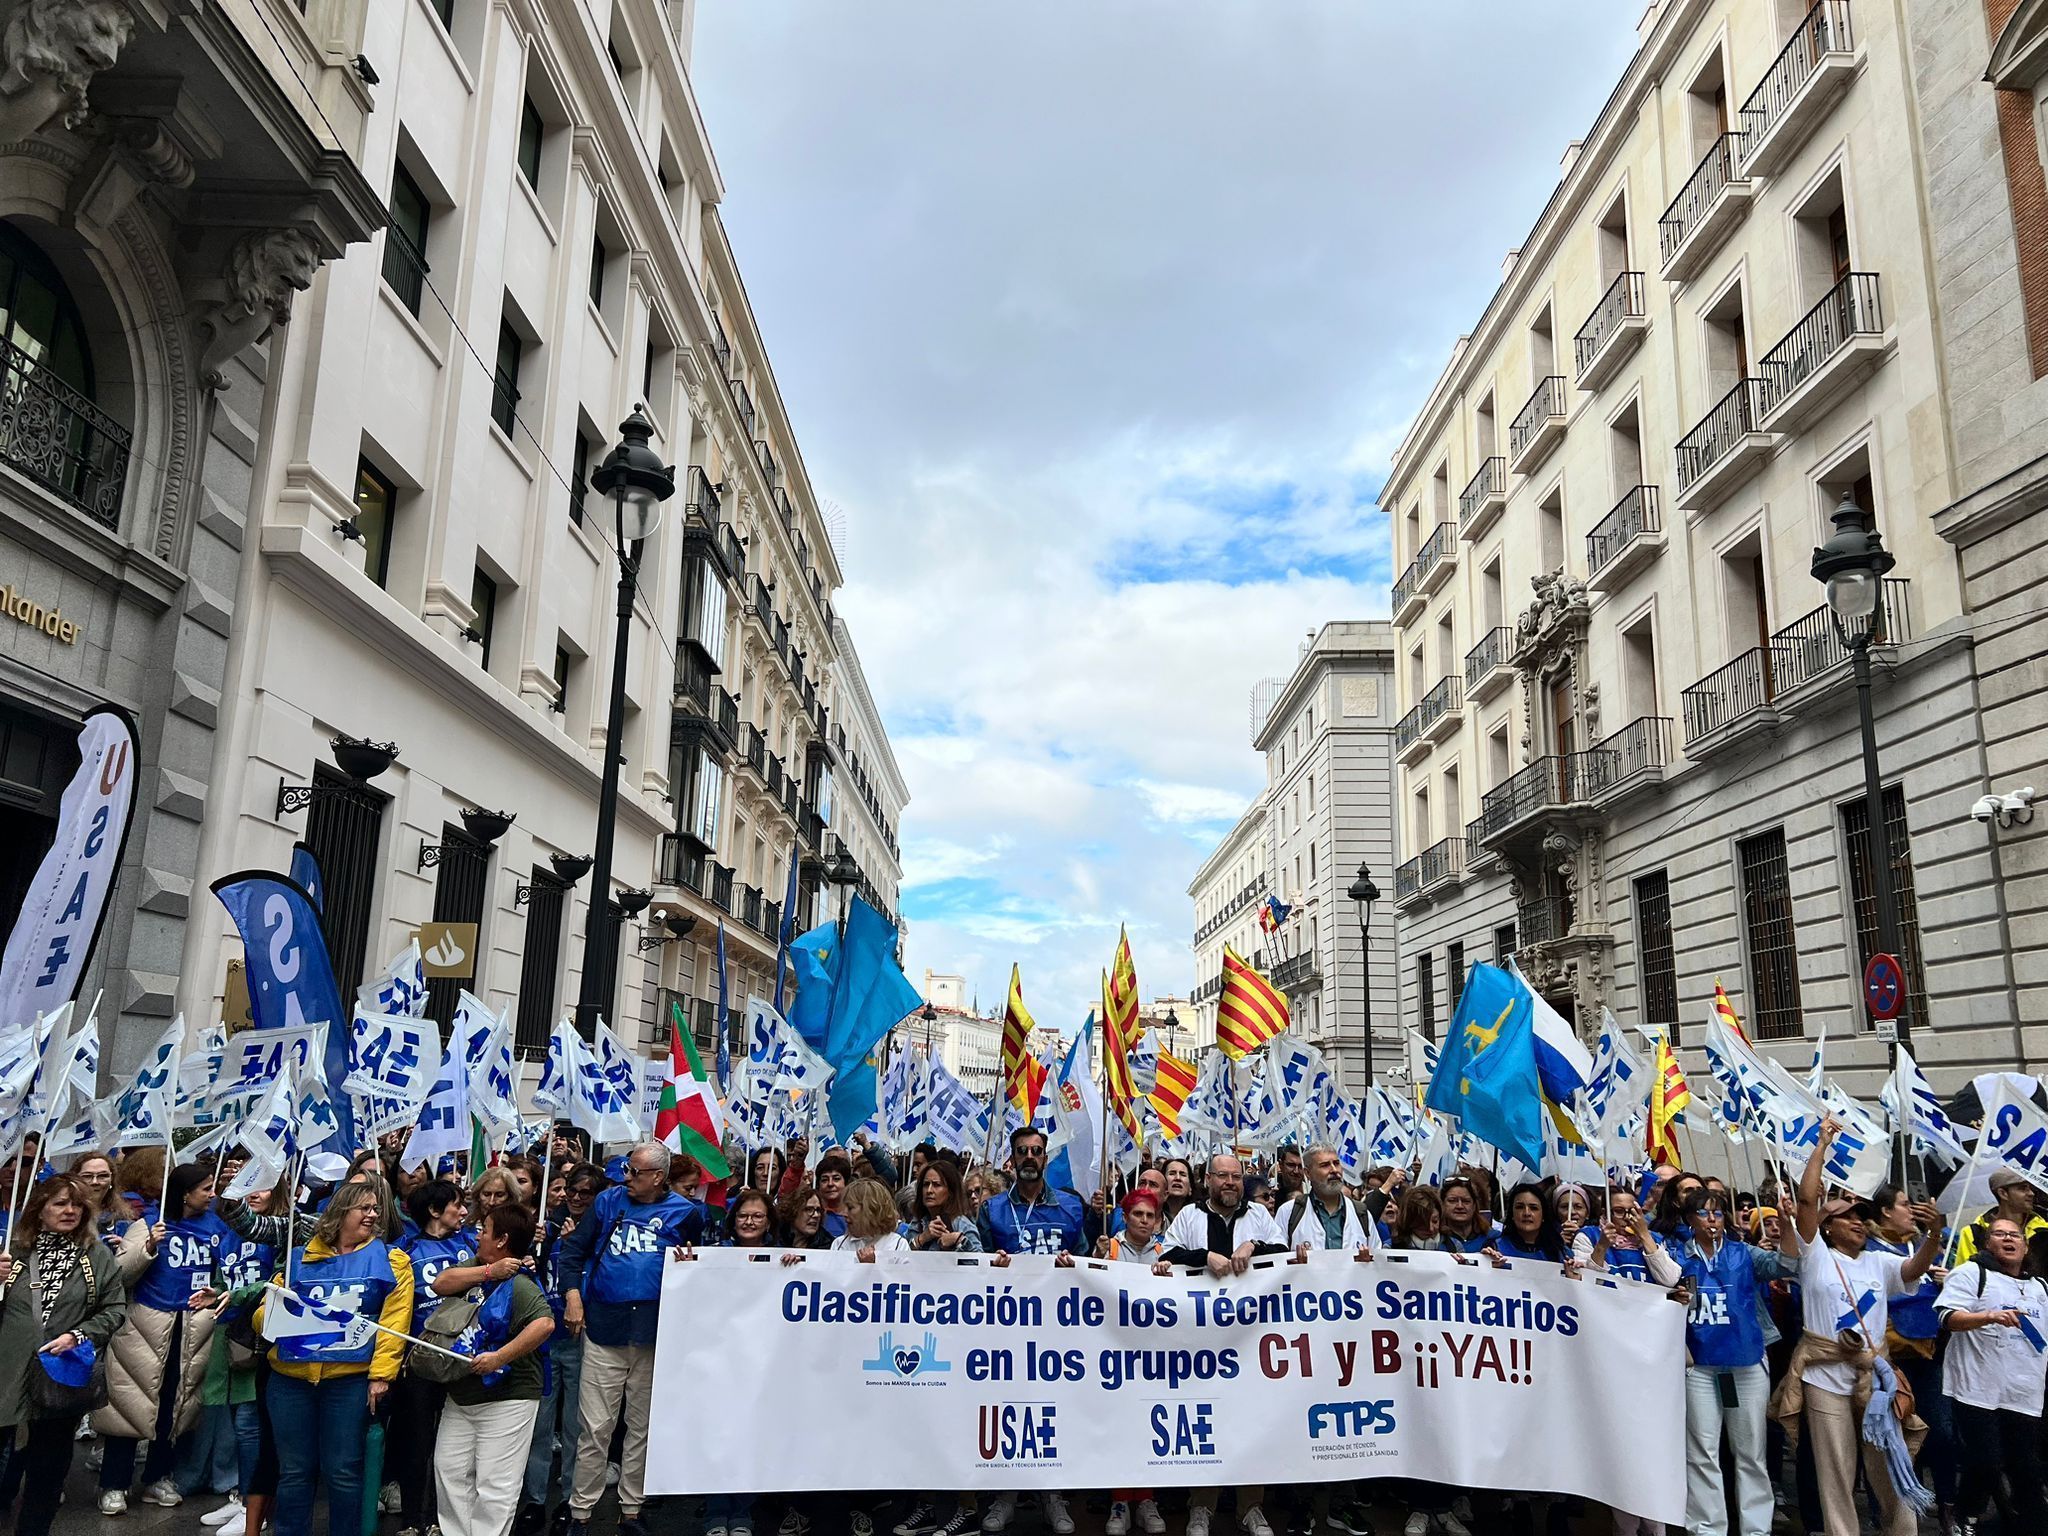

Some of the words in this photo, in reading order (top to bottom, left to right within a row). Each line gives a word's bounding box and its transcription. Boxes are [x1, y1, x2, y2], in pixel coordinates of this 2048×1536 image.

[782, 1280, 1042, 1326] Clasificación
[1057, 1287, 1104, 1326] de
[1119, 1289, 1178, 1327] los
[1187, 1284, 1363, 1327] Técnicos
[1376, 1280, 1579, 1336] Sanitarios
[966, 1349, 1013, 1381] en
[1027, 1341, 1085, 1381] los
[1099, 1348, 1240, 1391] grupos
[1259, 1333, 1313, 1379] C1
[1333, 1341, 1357, 1387] y
[1371, 1330, 1402, 1374] B
[1414, 1331, 1532, 1388] ¡¡YA!!
[1308, 1399, 1396, 1439] FTPS
[1312, 1444, 1344, 1452] FEDERACIÓN
[1352, 1441, 1376, 1449] TÉCNICOS
[1317, 1452, 1358, 1460] PROFESIONALES
